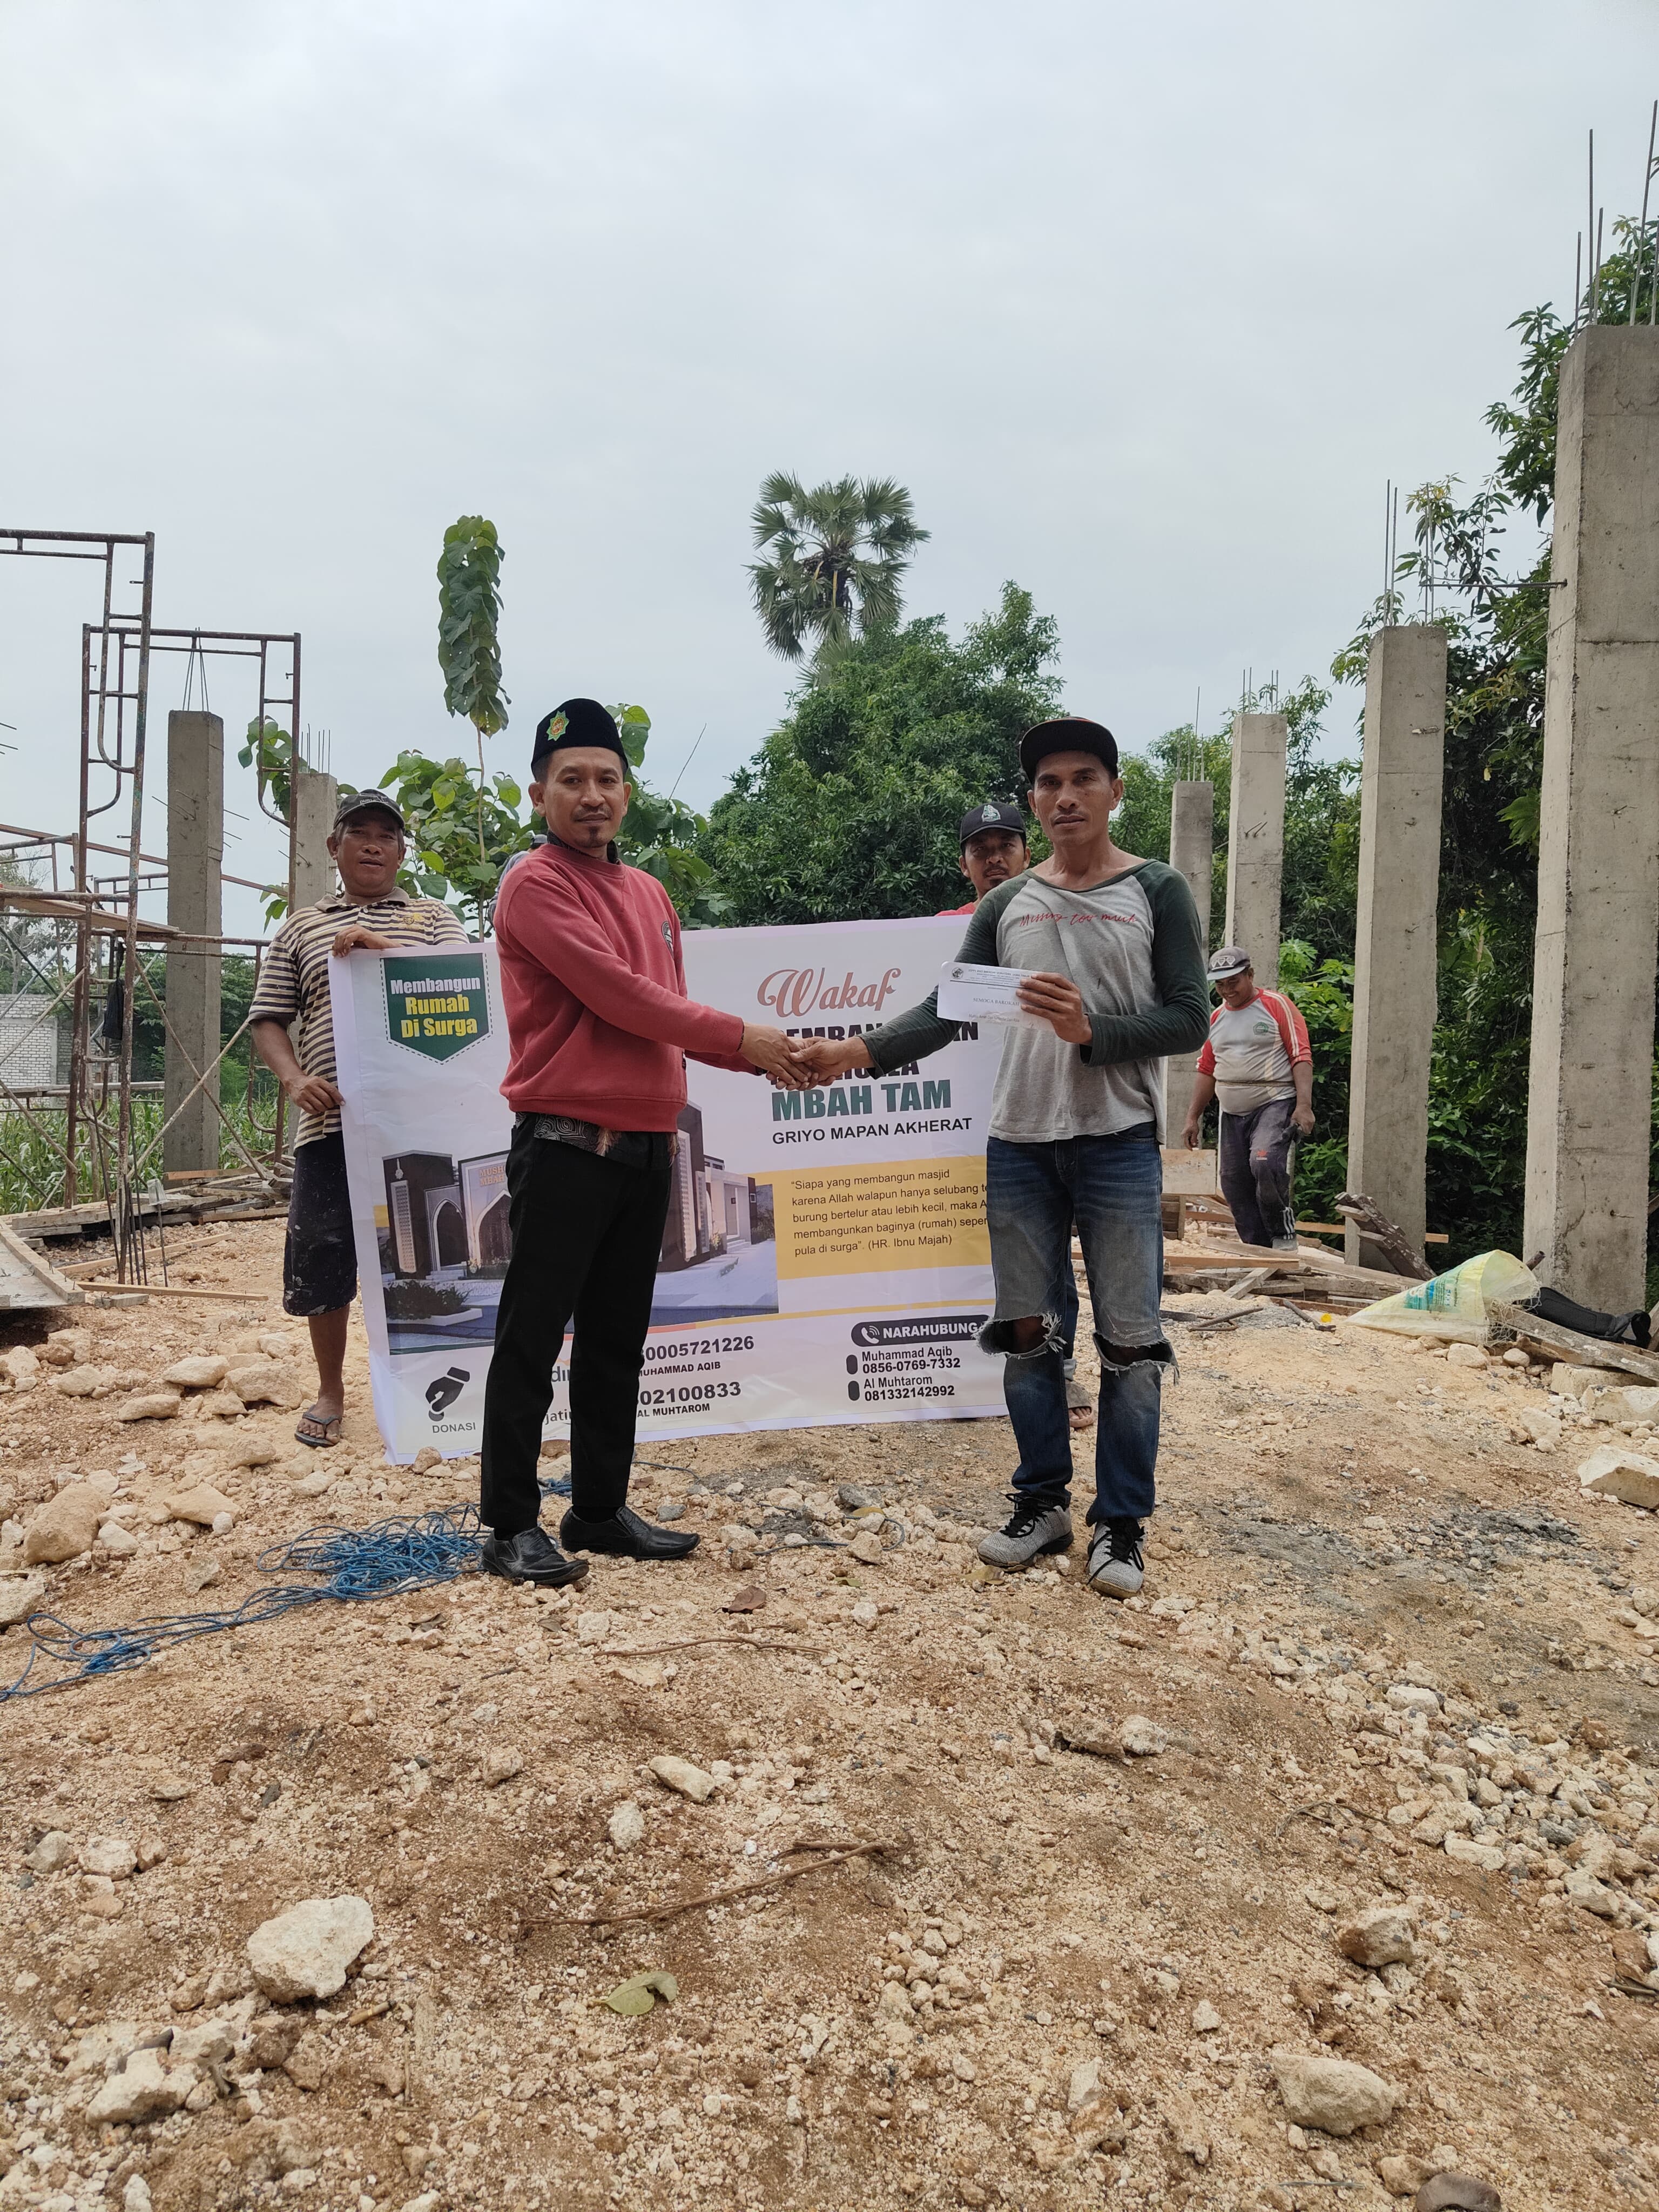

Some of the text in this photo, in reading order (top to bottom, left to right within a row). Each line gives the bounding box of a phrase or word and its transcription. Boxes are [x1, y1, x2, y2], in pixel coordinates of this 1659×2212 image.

[1020, 912, 1067, 927] Missing
[1070, 914, 1097, 926] too
[390, 977, 481, 994] Membangun
[757, 967, 901, 1017] Wakaf
[406, 994, 469, 1015] Rumah
[401, 1018, 478, 1038] Di Surga
[772, 1080, 952, 1122] MBAH TAM
[772, 1117, 972, 1144] GRIYO MAPAN AKHERAT
[480, 1165, 505, 1176] MUSH
[827, 1178, 851, 1189] yang
[854, 1174, 915, 1185] membangun
[918, 1169, 949, 1181] masjid
[792, 1197, 826, 1206] karena
[829, 1193, 853, 1204] Allah
[857, 1191, 897, 1201] walapun
[900, 1189, 930, 1198] hanya
[934, 1185, 978, 1195] selubang
[793, 1213, 828, 1223] burung
[831, 1209, 868, 1219] bertelur
[871, 1207, 893, 1216] atau
[895, 1205, 919, 1214] lebih
[922, 1202, 947, 1212] kecil,
[950, 1201, 977, 1210] maka
[794, 1218, 987, 1239] membangunkan baginya (rumah) seper
[795, 1246, 815, 1258] pula
[819, 1244, 827, 1253] di
[894, 1238, 915, 1246] Ibnu
[918, 1234, 952, 1246] Majah)
[883, 1322, 978, 1338] NARAHUBUNG
[642, 1335, 754, 1361] 0005721226
[862, 1346, 953, 1362] Muhammad Aqib
[697, 1361, 721, 1372] AQIB
[862, 1357, 961, 1374] 0856-0769-7332
[864, 1376, 933, 1389] Al Muhtarom
[637, 1381, 741, 1405] 02100833
[865, 1385, 955, 1401] 081332142992
[545, 1408, 571, 1425] jati
[637, 1403, 711, 1418] AL MUHTAROM
[432, 1422, 476, 1433] DONASI
